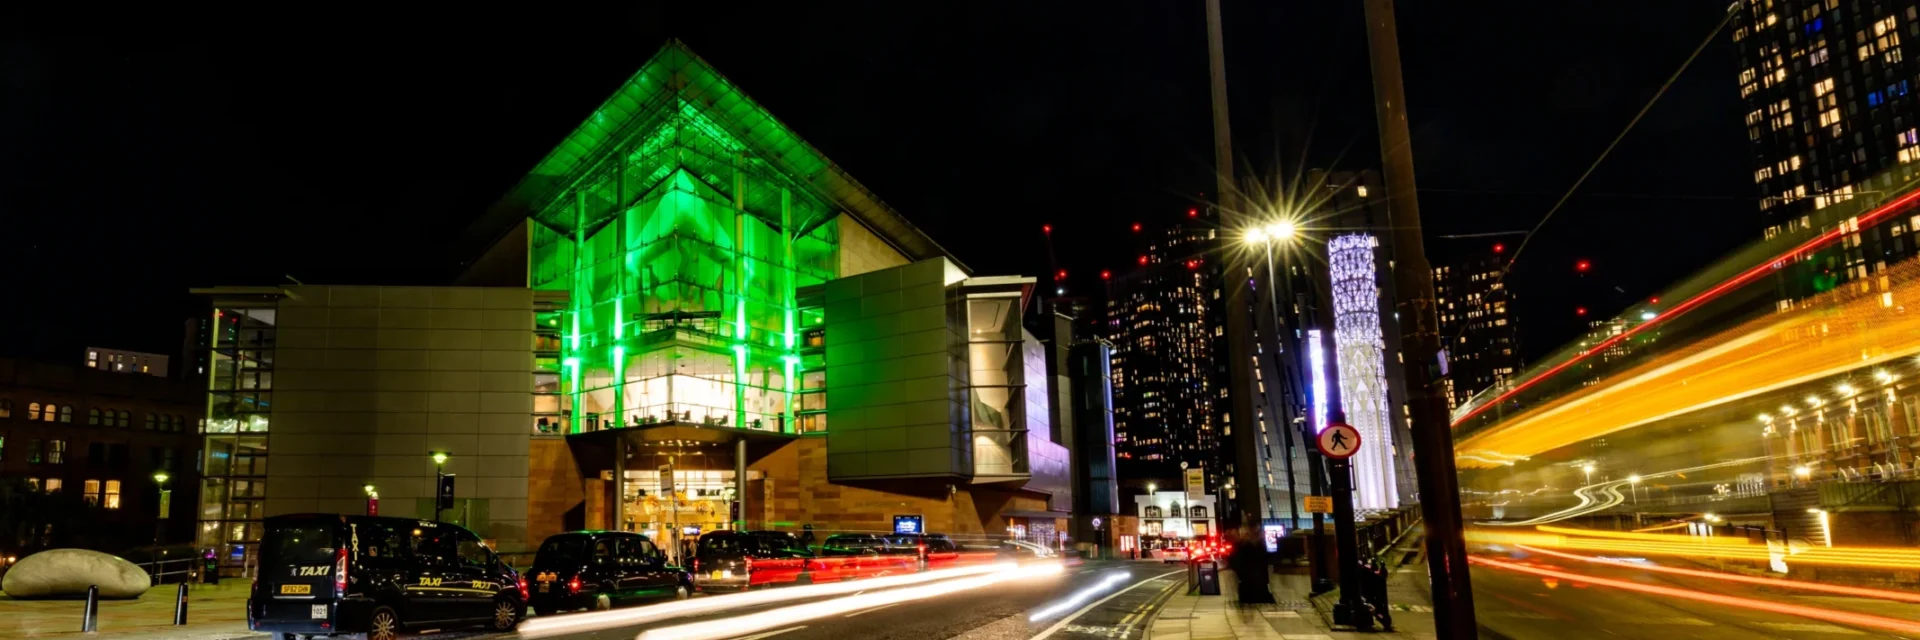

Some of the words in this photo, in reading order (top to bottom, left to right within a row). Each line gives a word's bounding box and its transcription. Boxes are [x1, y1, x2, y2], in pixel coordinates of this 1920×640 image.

[350, 523, 359, 561] TAXI
[300, 566, 330, 576] TAXI
[419, 577, 442, 587] TAXI
[472, 580, 491, 589] TAXI
